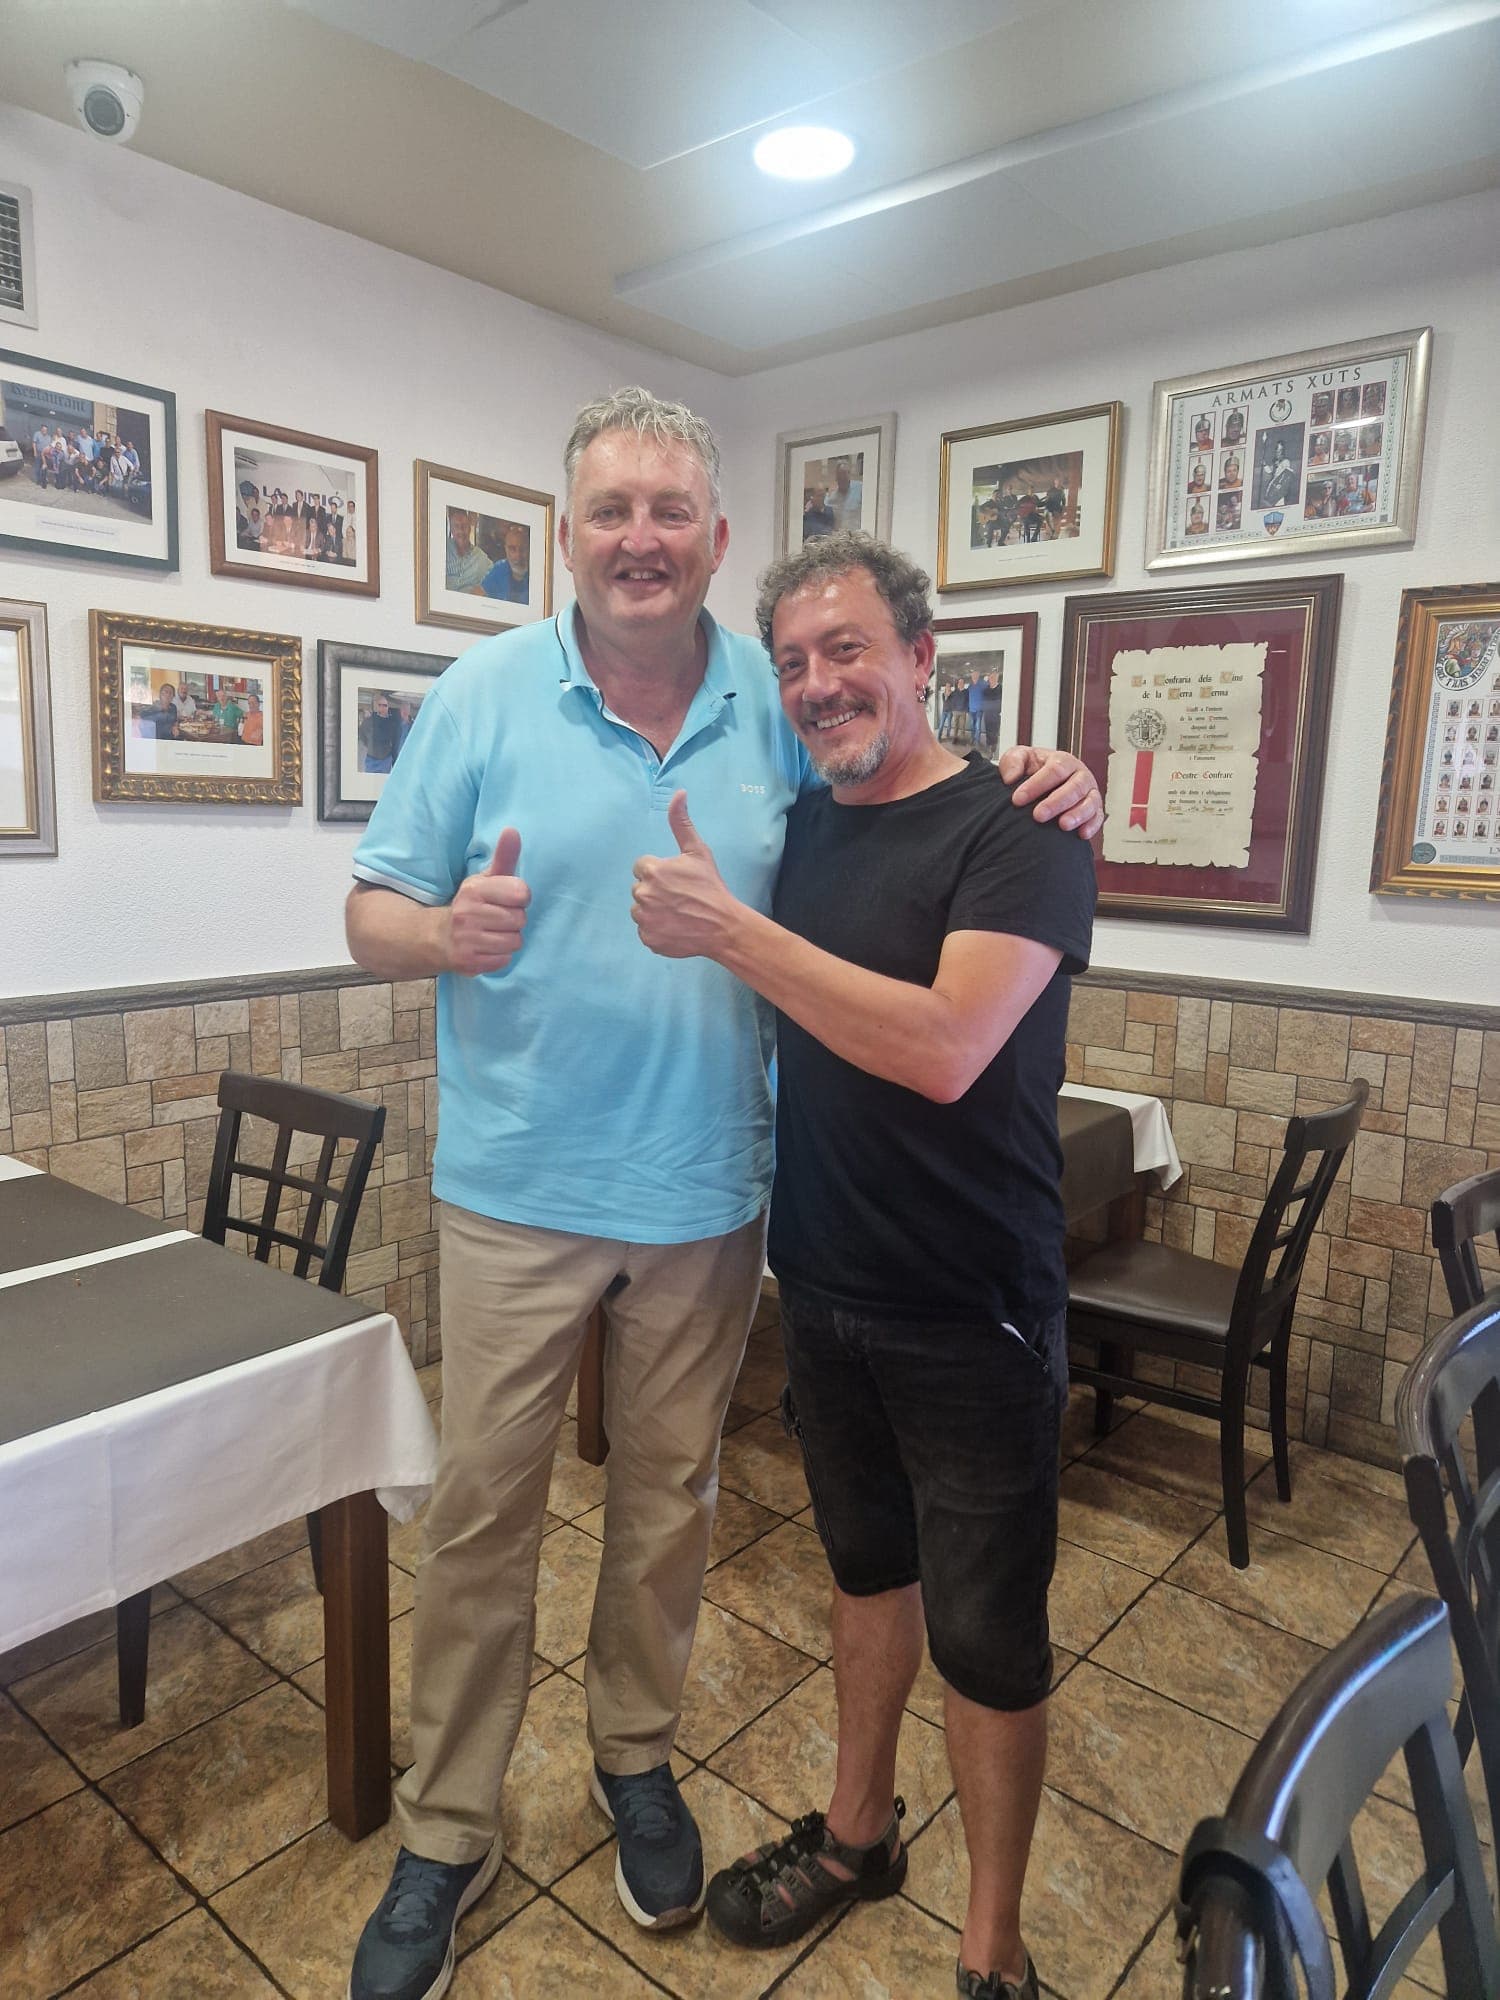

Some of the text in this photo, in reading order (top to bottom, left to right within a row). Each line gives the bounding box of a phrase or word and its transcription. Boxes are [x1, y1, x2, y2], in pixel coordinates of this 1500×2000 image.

[1211, 367, 1361, 408] ARMATS XUTS
[1155, 690, 1162, 699] la
